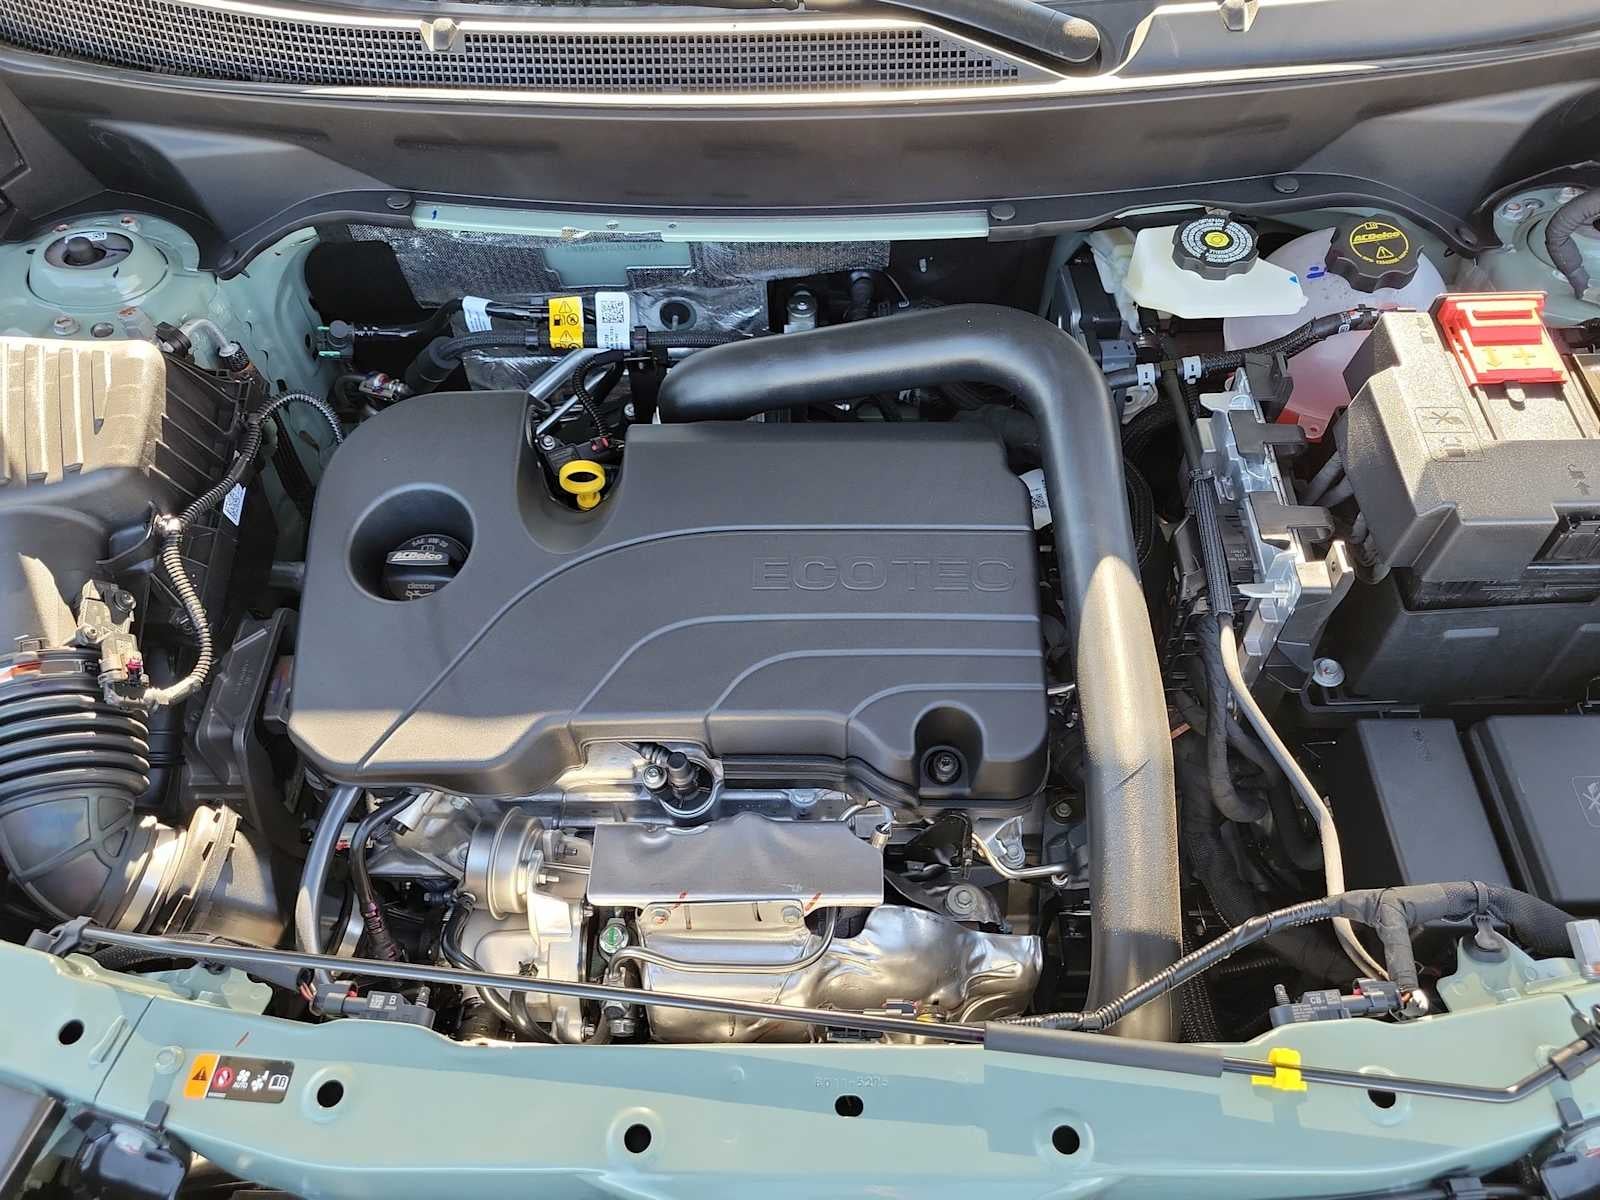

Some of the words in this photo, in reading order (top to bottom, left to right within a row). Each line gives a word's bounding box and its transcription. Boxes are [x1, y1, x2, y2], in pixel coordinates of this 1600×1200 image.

[1352, 231, 1401, 244] ACDelco
[391, 551, 443, 562] ACDelco
[751, 555, 1017, 592] ECOTEC
